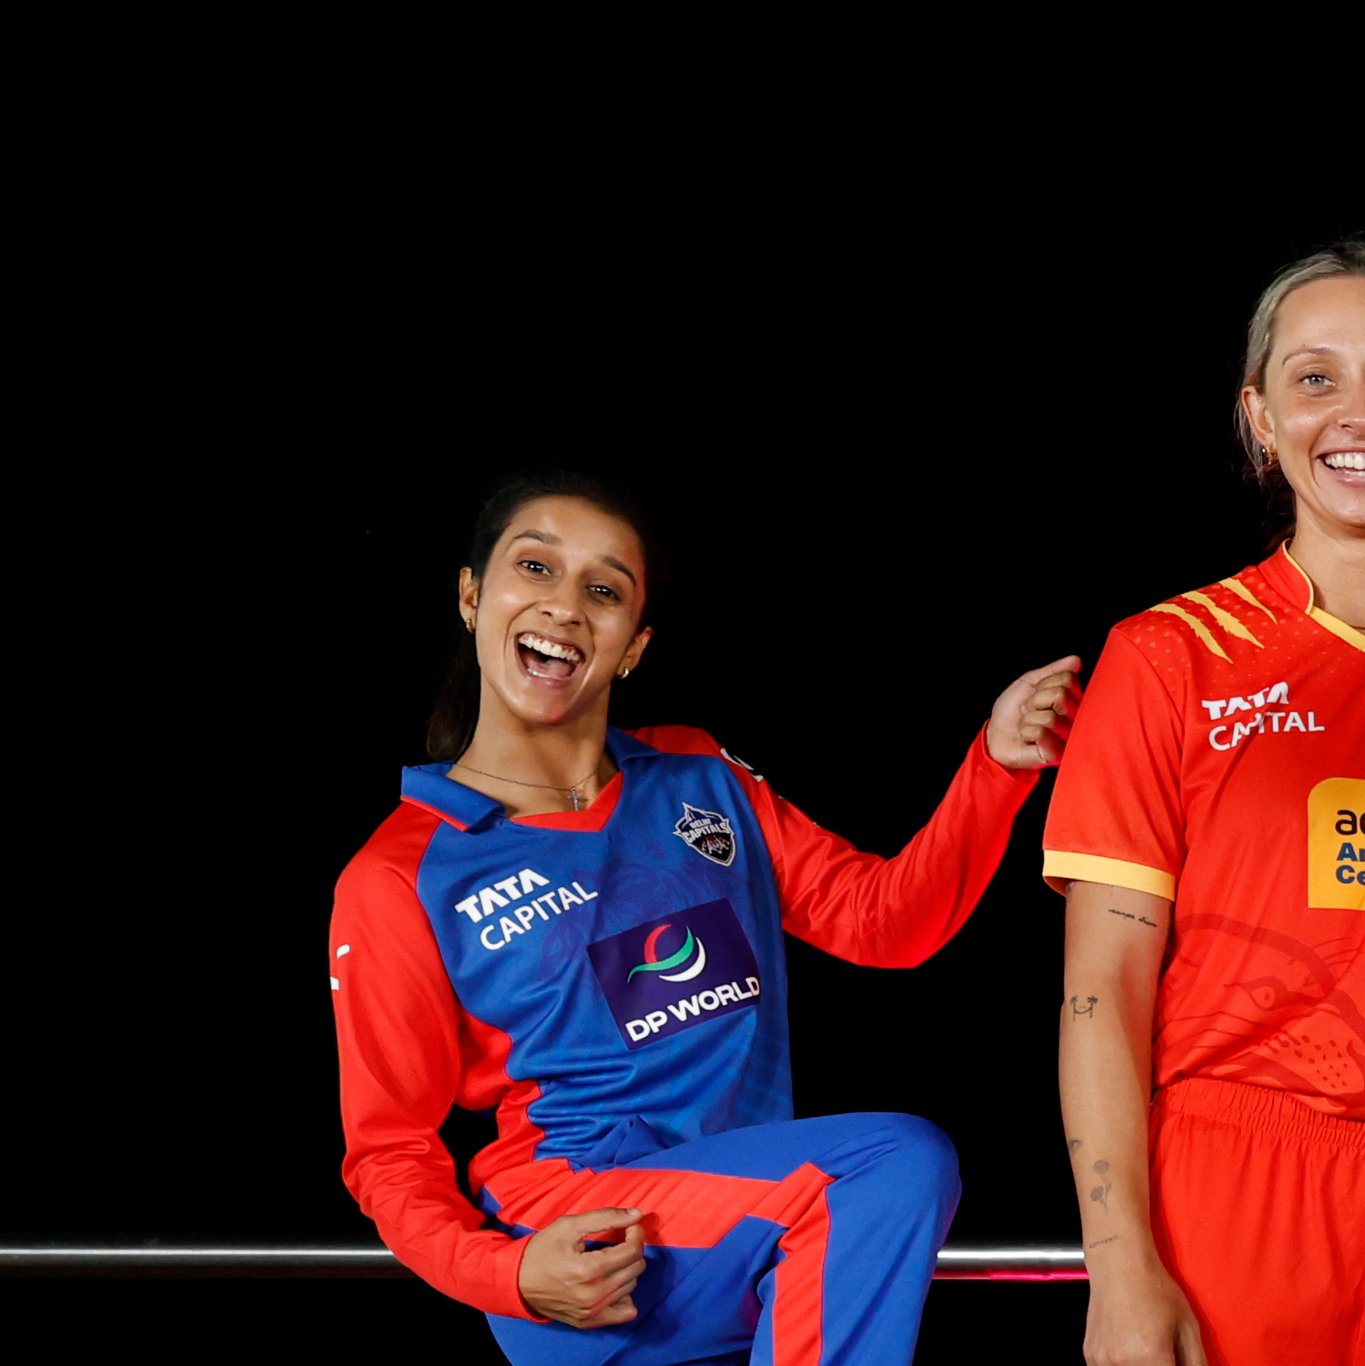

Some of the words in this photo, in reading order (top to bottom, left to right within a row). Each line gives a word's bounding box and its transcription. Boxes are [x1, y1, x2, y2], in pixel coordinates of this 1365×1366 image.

[1200, 680, 1290, 721] TATA
[681, 821, 732, 844] CAPITALS
[454, 868, 550, 924] TATA
[479, 880, 600, 951] CAPITAL
[624, 1010, 669, 1043] DP
[666, 975, 761, 1024] WORLD
